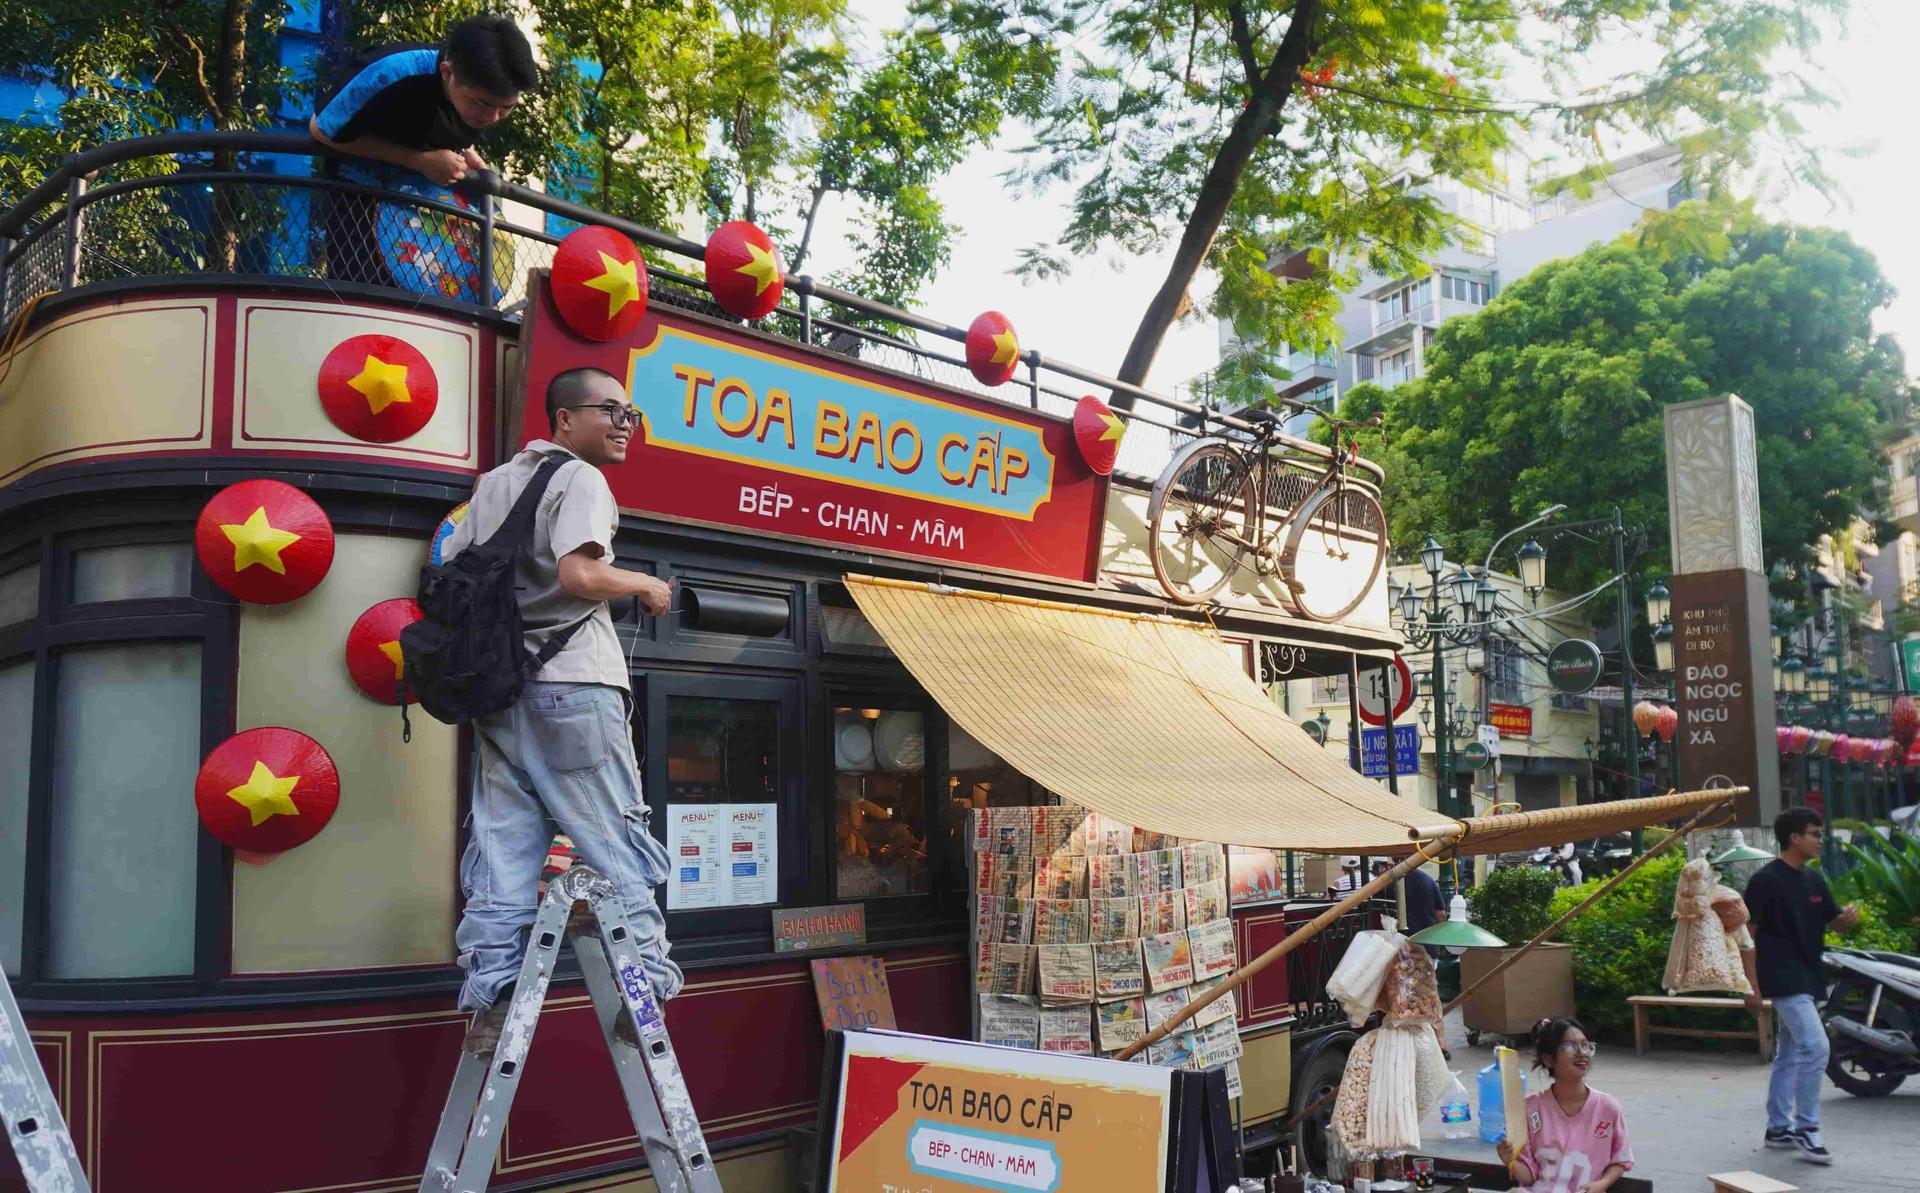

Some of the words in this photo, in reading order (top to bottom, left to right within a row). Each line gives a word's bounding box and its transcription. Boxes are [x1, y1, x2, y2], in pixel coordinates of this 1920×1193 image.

[673, 363, 796, 449] TOA
[814, 399, 922, 474] BAO
[936, 428, 1030, 495] CẤP
[738, 481, 793, 518] BẾP
[817, 501, 888, 537] CHẠN
[910, 518, 965, 550] MÂM
[1683, 610, 1705, 619] KHU
[1686, 683, 1742, 702] NGỌC
[1687, 704, 1729, 723] NGŨ
[1394, 729, 1408, 749] XÃ
[1408, 733, 1413, 748] 1
[1689, 727, 1716, 745] XÃ
[910, 1081, 953, 1115] TOA
[962, 1089, 1012, 1123] BAO
[1020, 1090, 1073, 1132] CẤP
[929, 1138, 951, 1159] BẾP
[961, 1147, 995, 1169] CHẠN
[1005, 1154, 1036, 1177] MÂM
